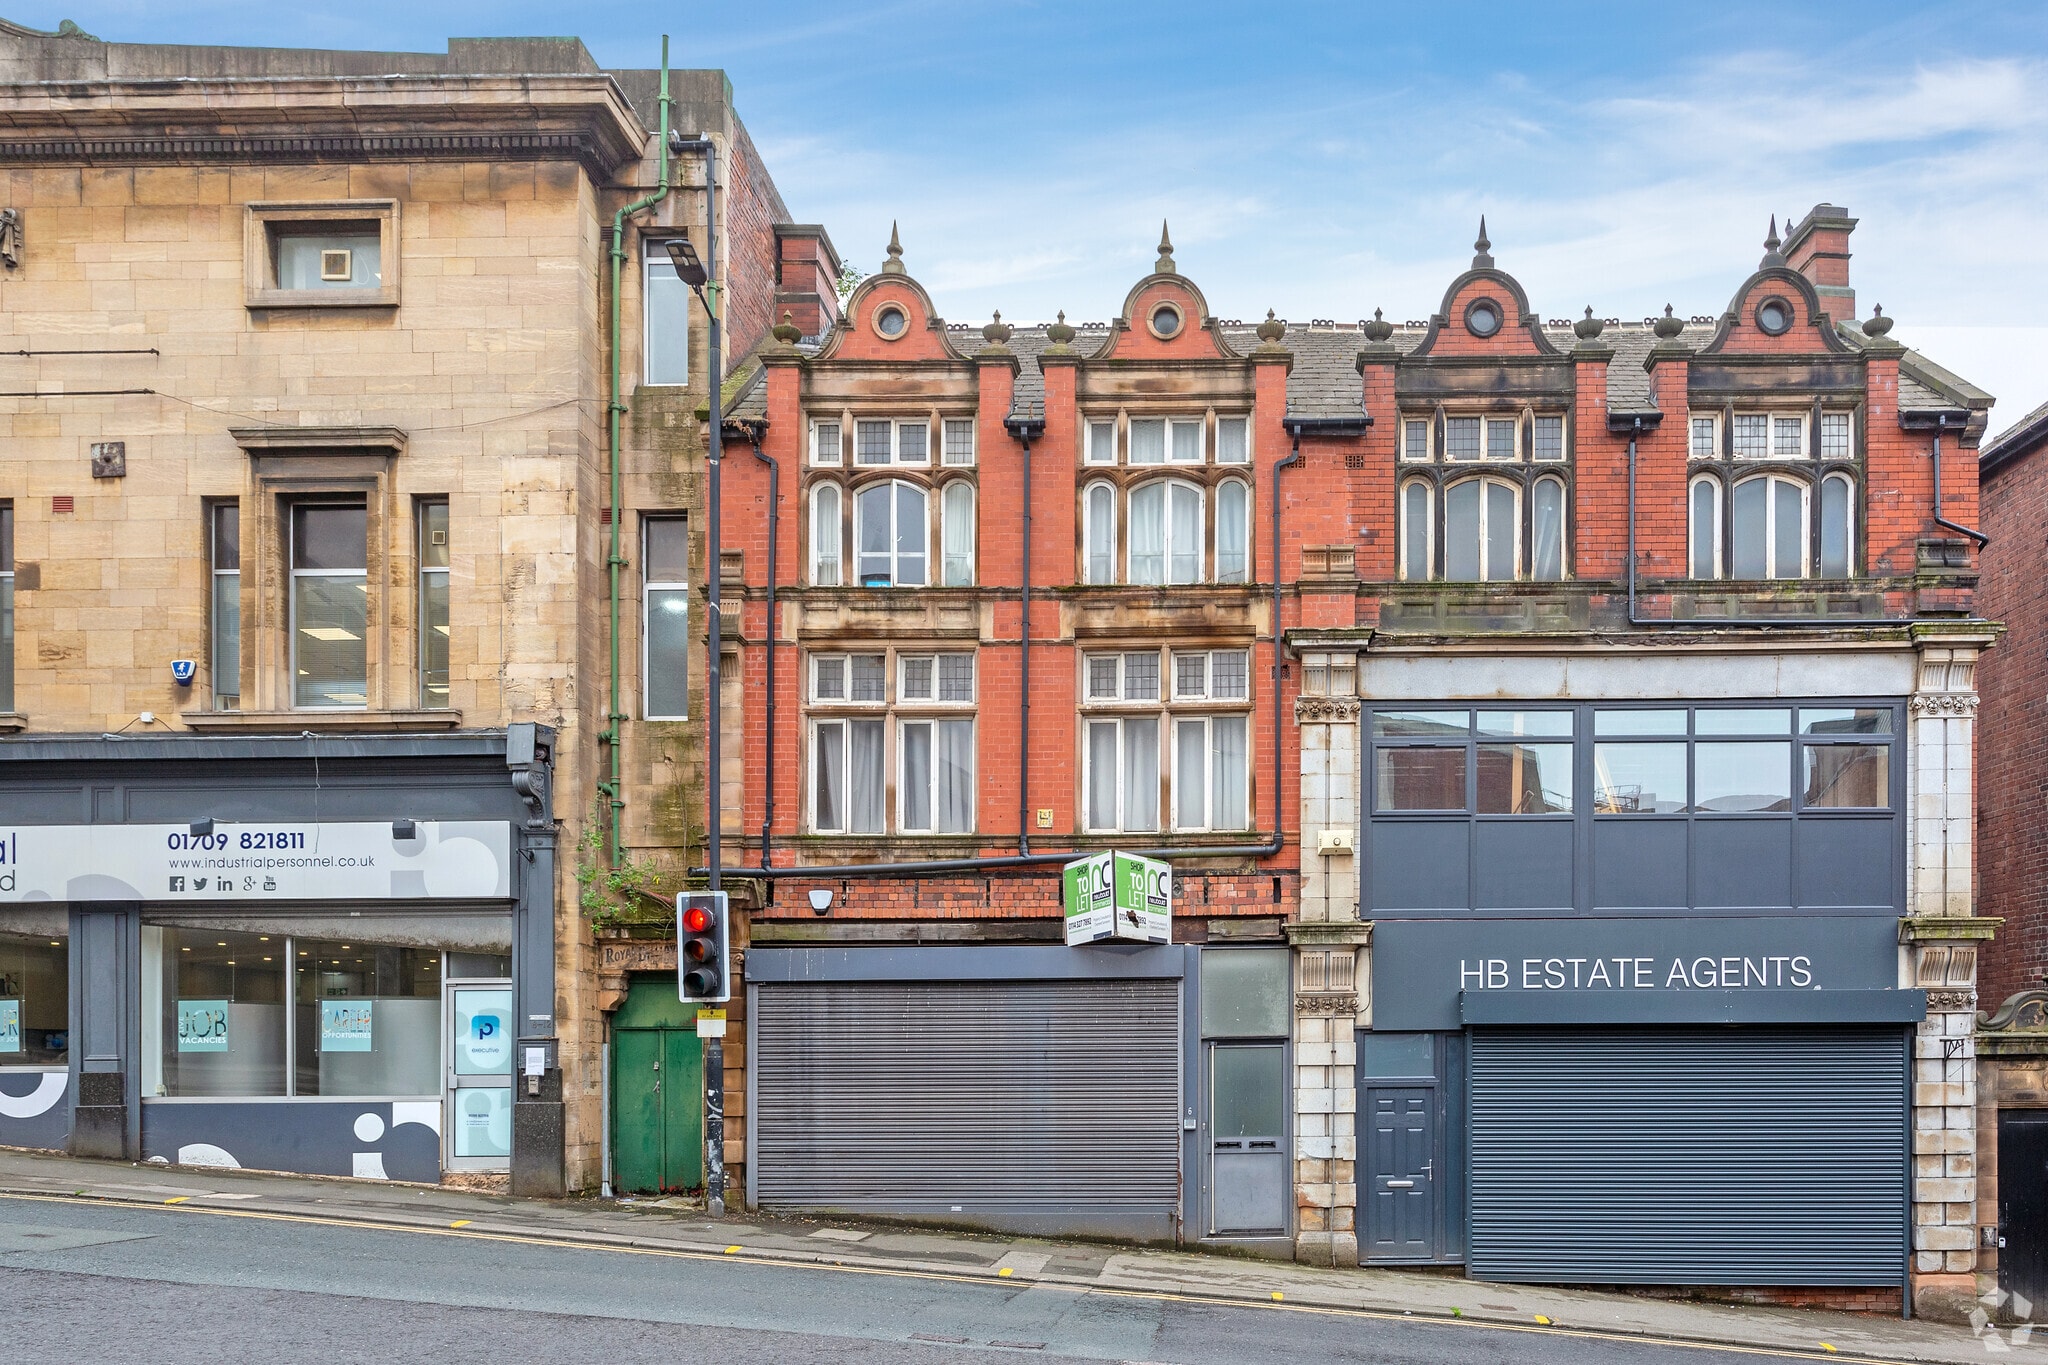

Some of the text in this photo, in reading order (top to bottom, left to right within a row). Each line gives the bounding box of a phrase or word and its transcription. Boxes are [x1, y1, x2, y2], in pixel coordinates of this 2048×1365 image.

[168, 832, 304, 850] 01709 821811
[169, 855, 375, 870] www.industrialpersonnel.co.uk
[1077, 865, 1088, 876] SHOP
[1130, 862, 1143, 871] SHOP
[1077, 876, 1088, 894] TO
[1130, 873, 1144, 890] TO
[1076, 893, 1089, 912] LET
[1128, 890, 1144, 908] LET
[1460, 956, 1812, 989] HB ESTATE AGENTS
[180, 1009, 226, 1037] JOB
[322, 1008, 371, 1033] CAREER
[1187, 1106, 1193, 1115] 6
